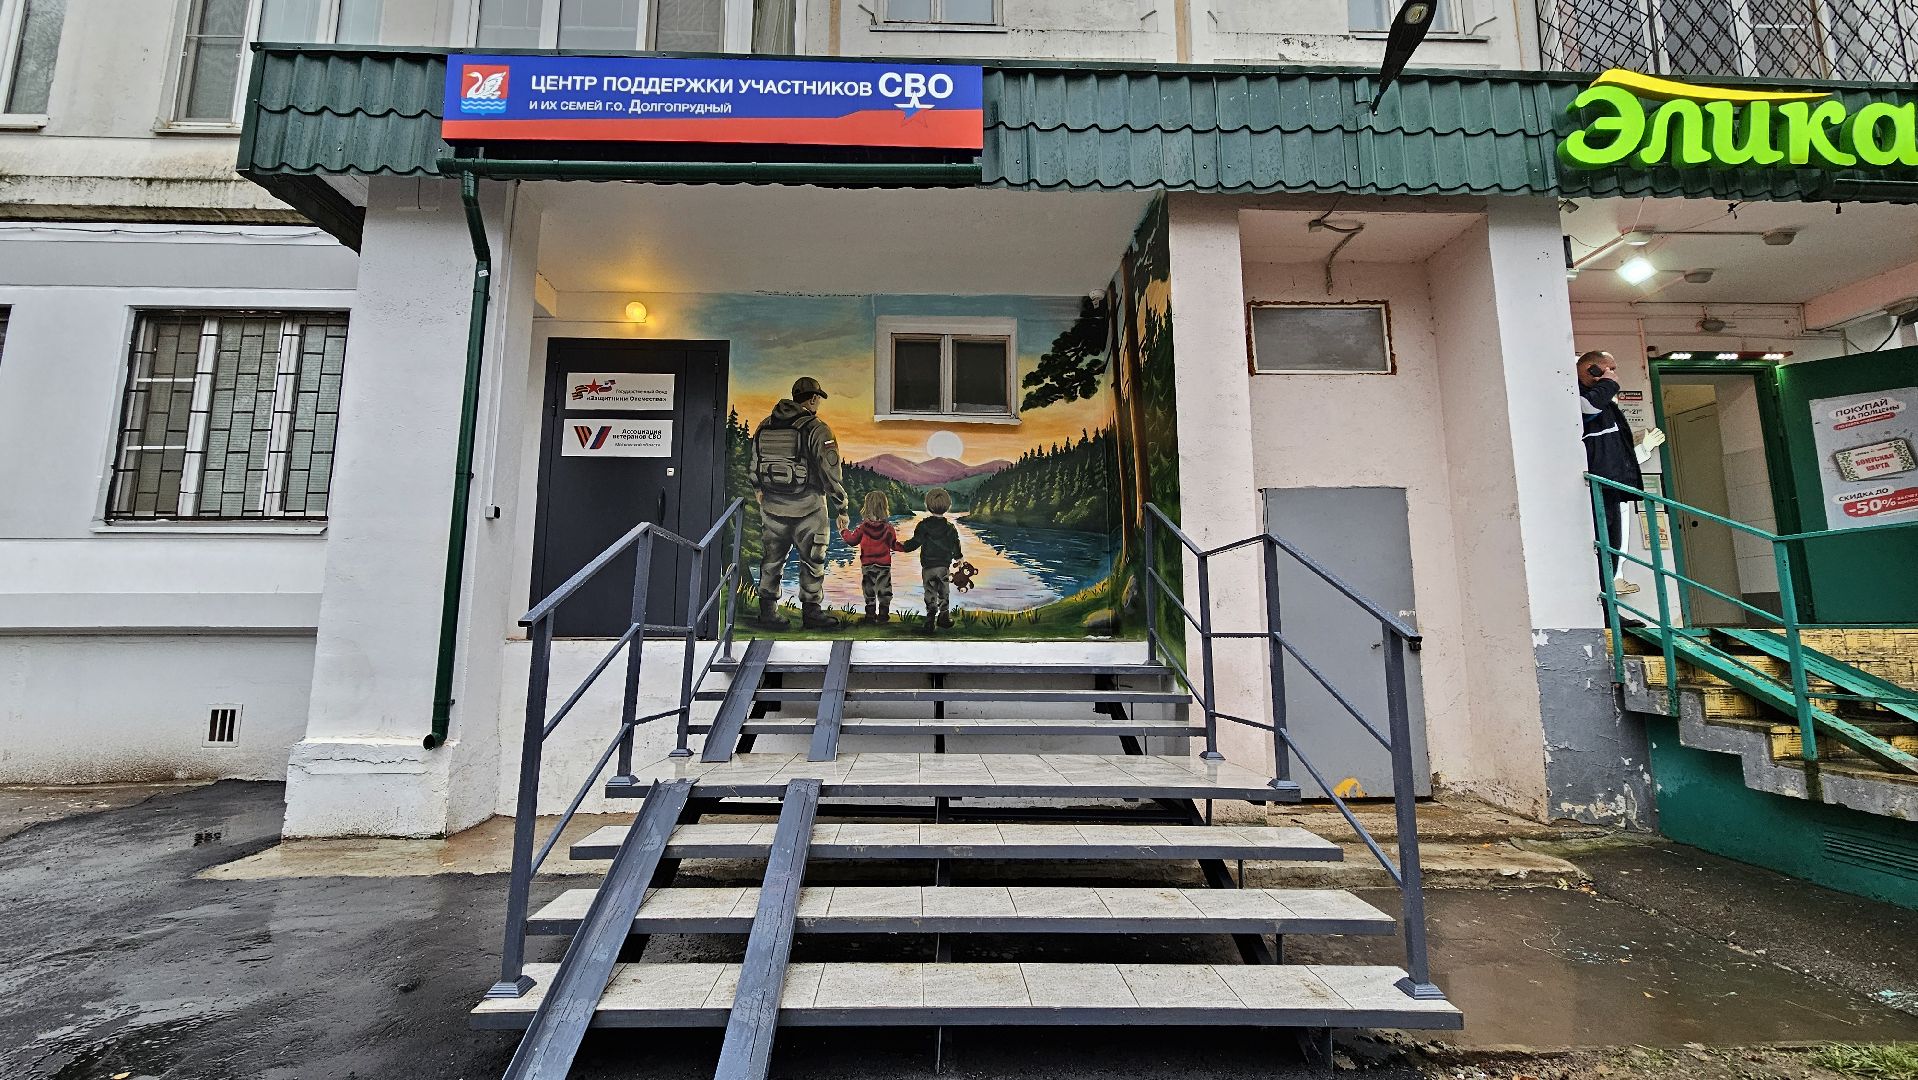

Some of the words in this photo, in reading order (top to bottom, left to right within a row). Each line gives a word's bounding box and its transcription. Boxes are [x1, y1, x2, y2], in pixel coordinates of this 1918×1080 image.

[531, 75, 598, 92] ЦЕНТР
[603, 76, 734, 95] ПОДДЕРЖКИ
[738, 79, 873, 97] УЧАСТНИКОВ
[878, 72, 954, 99] СВО
[529, 101, 538, 110] И
[540, 101, 557, 110] ИХ
[560, 100, 602, 111] СЕМЕЙ
[1562, 85, 1918, 168] Элика
[1835, 398, 1888, 417] ПОКУПАЙ
[621, 428, 662, 436] Ассоциация
[1838, 491, 1874, 502] СКИДКА
[1875, 488, 1889, 496] ДО
